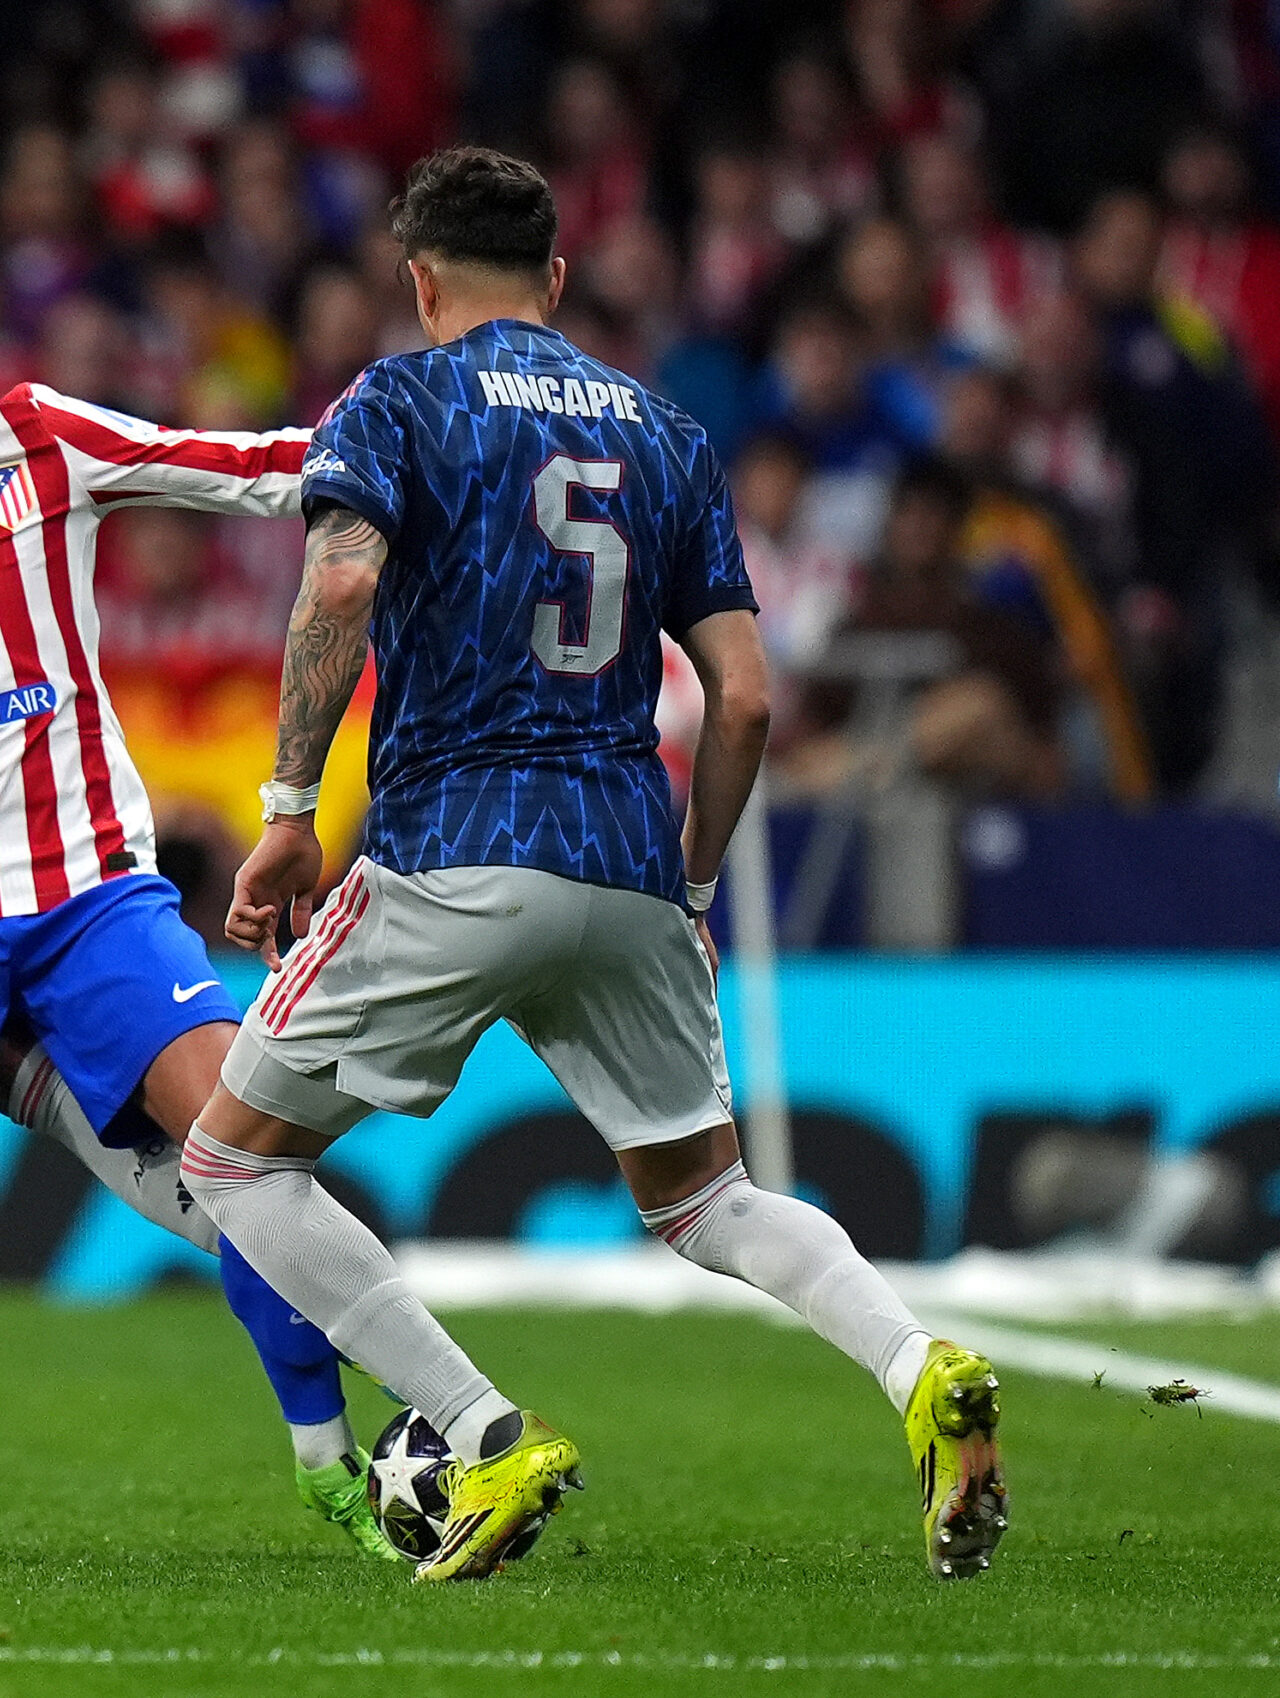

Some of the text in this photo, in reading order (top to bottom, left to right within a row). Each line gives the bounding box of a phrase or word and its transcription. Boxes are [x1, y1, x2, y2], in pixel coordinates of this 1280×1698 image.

[477, 370, 643, 424] HINCAPIE
[532, 453, 628, 677] 5
[6, 686, 53, 720] AIR
